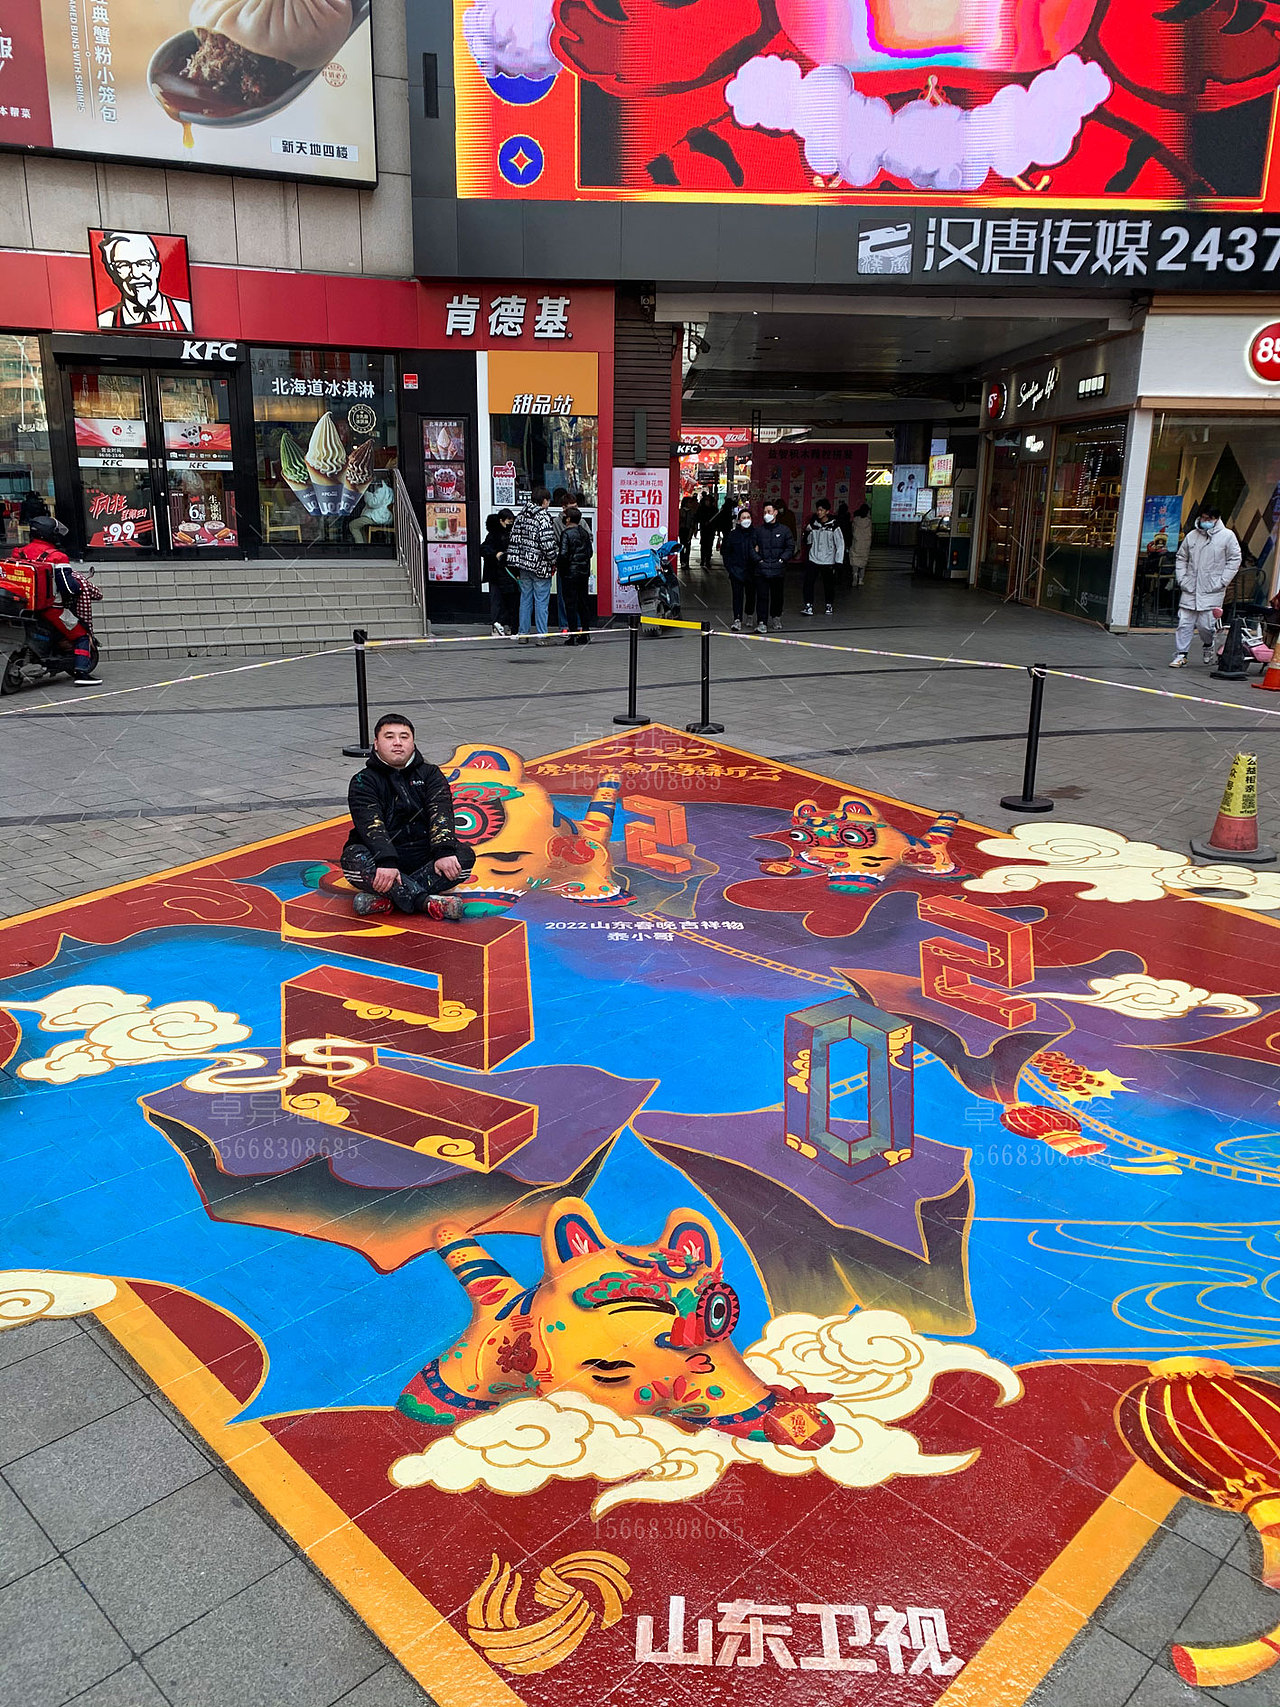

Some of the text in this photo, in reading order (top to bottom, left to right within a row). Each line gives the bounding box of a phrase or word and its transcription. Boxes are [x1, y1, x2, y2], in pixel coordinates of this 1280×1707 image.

[70, 25, 80, 49] BUNS
[72, 50, 82, 73] WITH
[90, 0, 118, 124] 典蟹粉小笼包
[74, 75, 86, 113] SHRIMPS
[281, 140, 349, 160] 新天地四楼
[923, 217, 1154, 276] 汉唐传媒
[445, 294, 570, 339] 肯德基
[181, 340, 237, 361] KFC
[271, 377, 376, 399] 北海道冰淇淋
[511, 394, 573, 415] 甜品站
[677, 445, 698, 453] KFC
[101, 459, 123, 467] KFC
[620, 488, 663, 506] 第2份
[622, 509, 659, 528] 半价
[582, 746, 721, 761] 2022
[634, 1594, 966, 1678] 山东卫视
